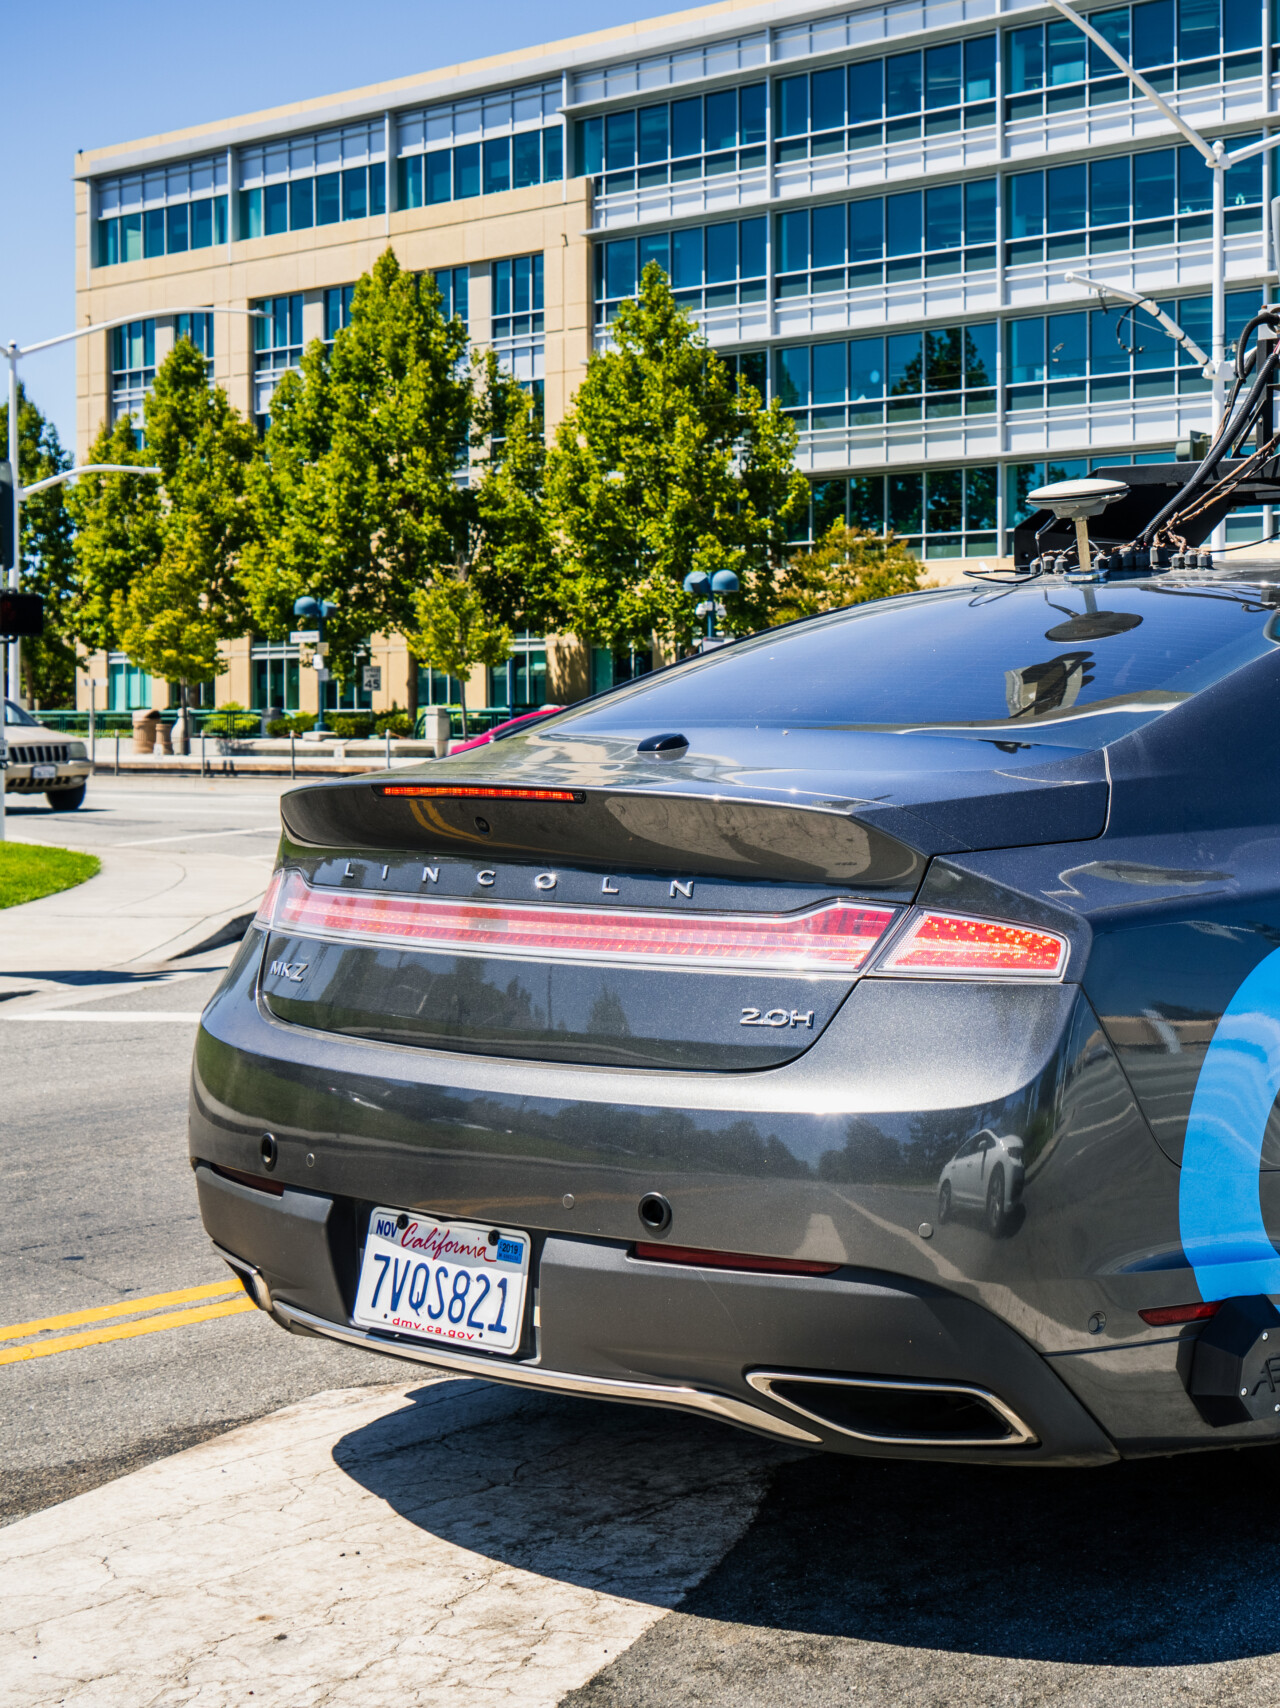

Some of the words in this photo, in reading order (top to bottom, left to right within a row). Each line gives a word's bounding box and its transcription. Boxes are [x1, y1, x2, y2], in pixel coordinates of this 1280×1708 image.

[364, 679, 381, 690] 45
[344, 862, 695, 898] LINCOLN
[270, 960, 309, 982] MKZ
[376, 1219, 398, 1238] NOV
[401, 1222, 497, 1263] California
[502, 1242, 519, 1255] 2019
[371, 1253, 508, 1334] 7VQS821
[392, 1317, 474, 1340] dmv.ca.gov
